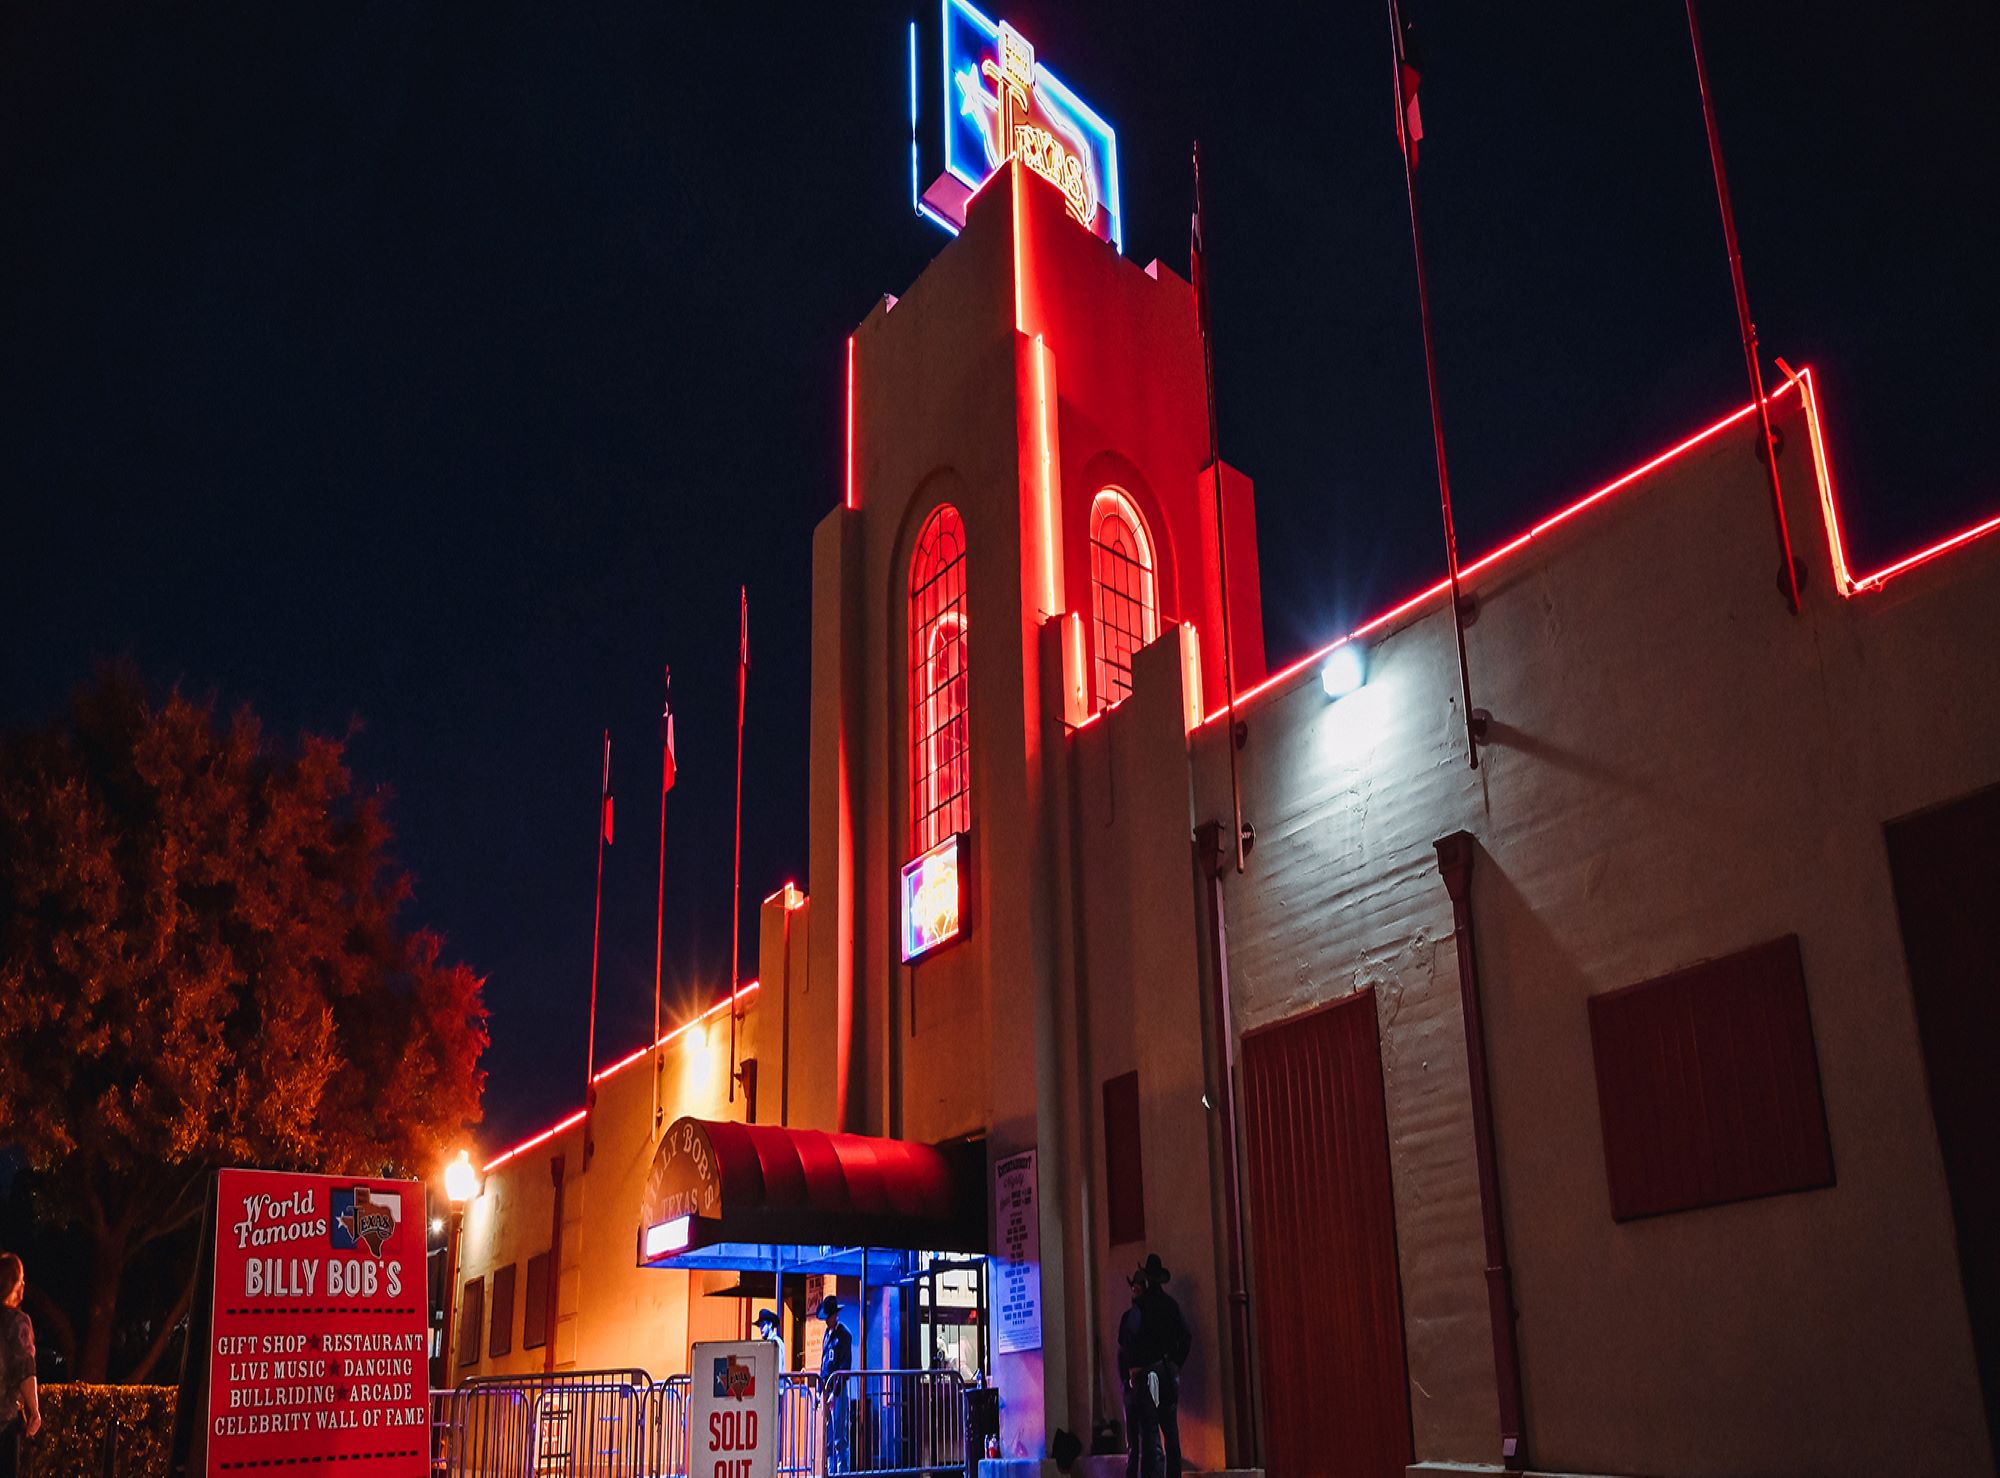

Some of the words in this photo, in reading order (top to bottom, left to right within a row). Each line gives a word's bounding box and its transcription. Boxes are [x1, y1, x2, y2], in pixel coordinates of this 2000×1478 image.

[243, 1189, 314, 1224] World
[234, 1218, 327, 1249] Famous
[245, 1259, 319, 1297] BILLY
[327, 1260, 402, 1297] BOB'S
[217, 1336, 258, 1355] GIFT
[262, 1335, 307, 1353] SHOP
[322, 1334, 423, 1352] RESTAURANT
[230, 1361, 268, 1381] LIVE
[274, 1360, 325, 1380] MUSIC
[344, 1358, 413, 1377] DANCING
[230, 1385, 335, 1408] BULLRIDING
[350, 1383, 412, 1402] ARCADE
[215, 1412, 311, 1436] CELEBRITY
[316, 1410, 358, 1430] WALL
[363, 1409, 381, 1427] OF
[386, 1407, 425, 1426] FAME
[709, 1410, 758, 1452] SOLD
